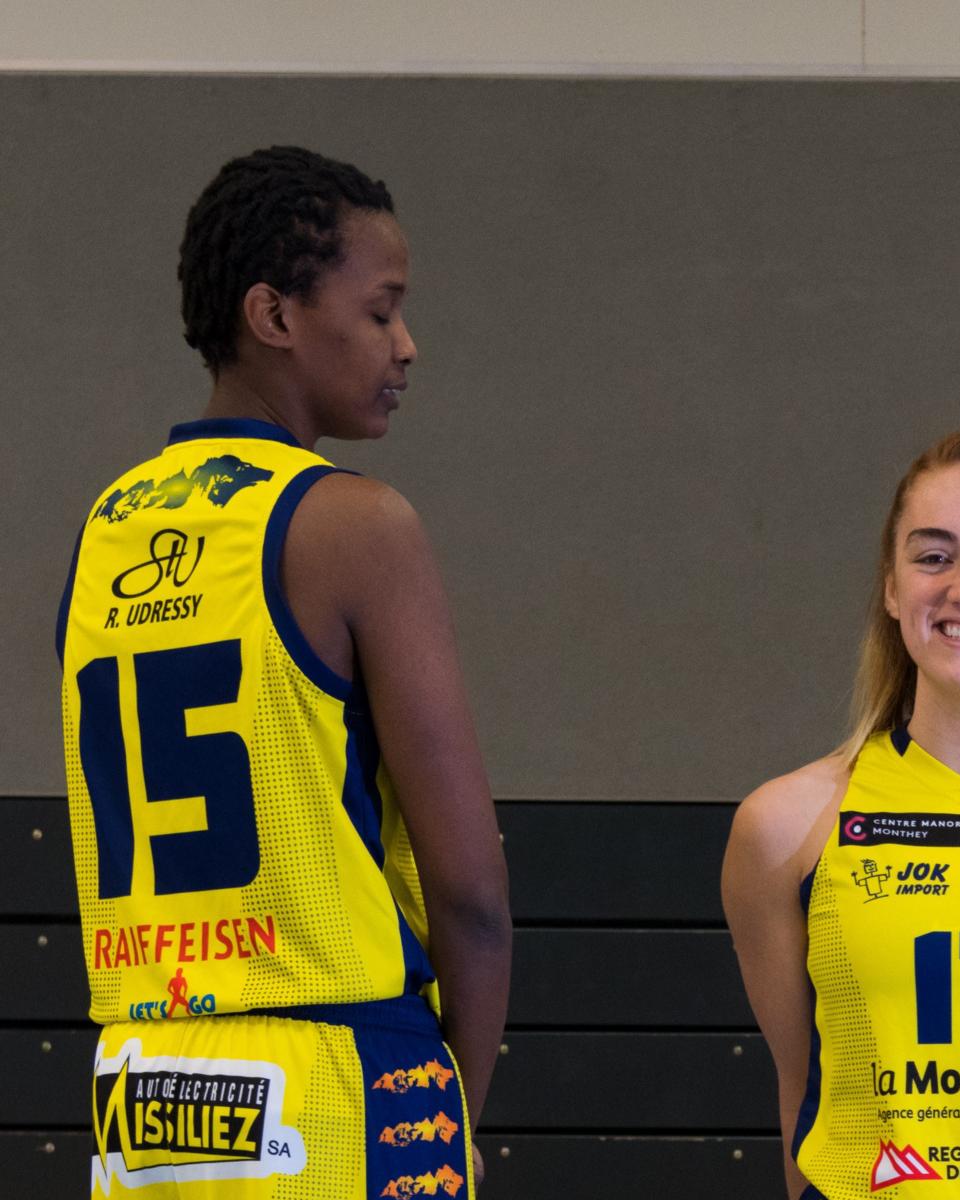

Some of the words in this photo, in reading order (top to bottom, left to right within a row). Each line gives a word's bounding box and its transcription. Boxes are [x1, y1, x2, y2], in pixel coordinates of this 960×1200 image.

[104, 607, 121, 629] R.
[126, 594, 203, 627] UDRESSY
[76, 638, 261, 899] 15
[872, 827, 928, 839] MONTHEY
[873, 819, 917, 828] CENTRE
[921, 820, 960, 828] MANOR
[897, 862, 950, 882] JOK
[896, 884, 949, 896] IMPORT
[94, 915, 276, 970] RAIFFEISEN
[129, 1000, 168, 1020] LET'S
[188, 993, 216, 1014] GO
[871, 1062, 897, 1096] la
[267, 1140, 291, 1158] SA
